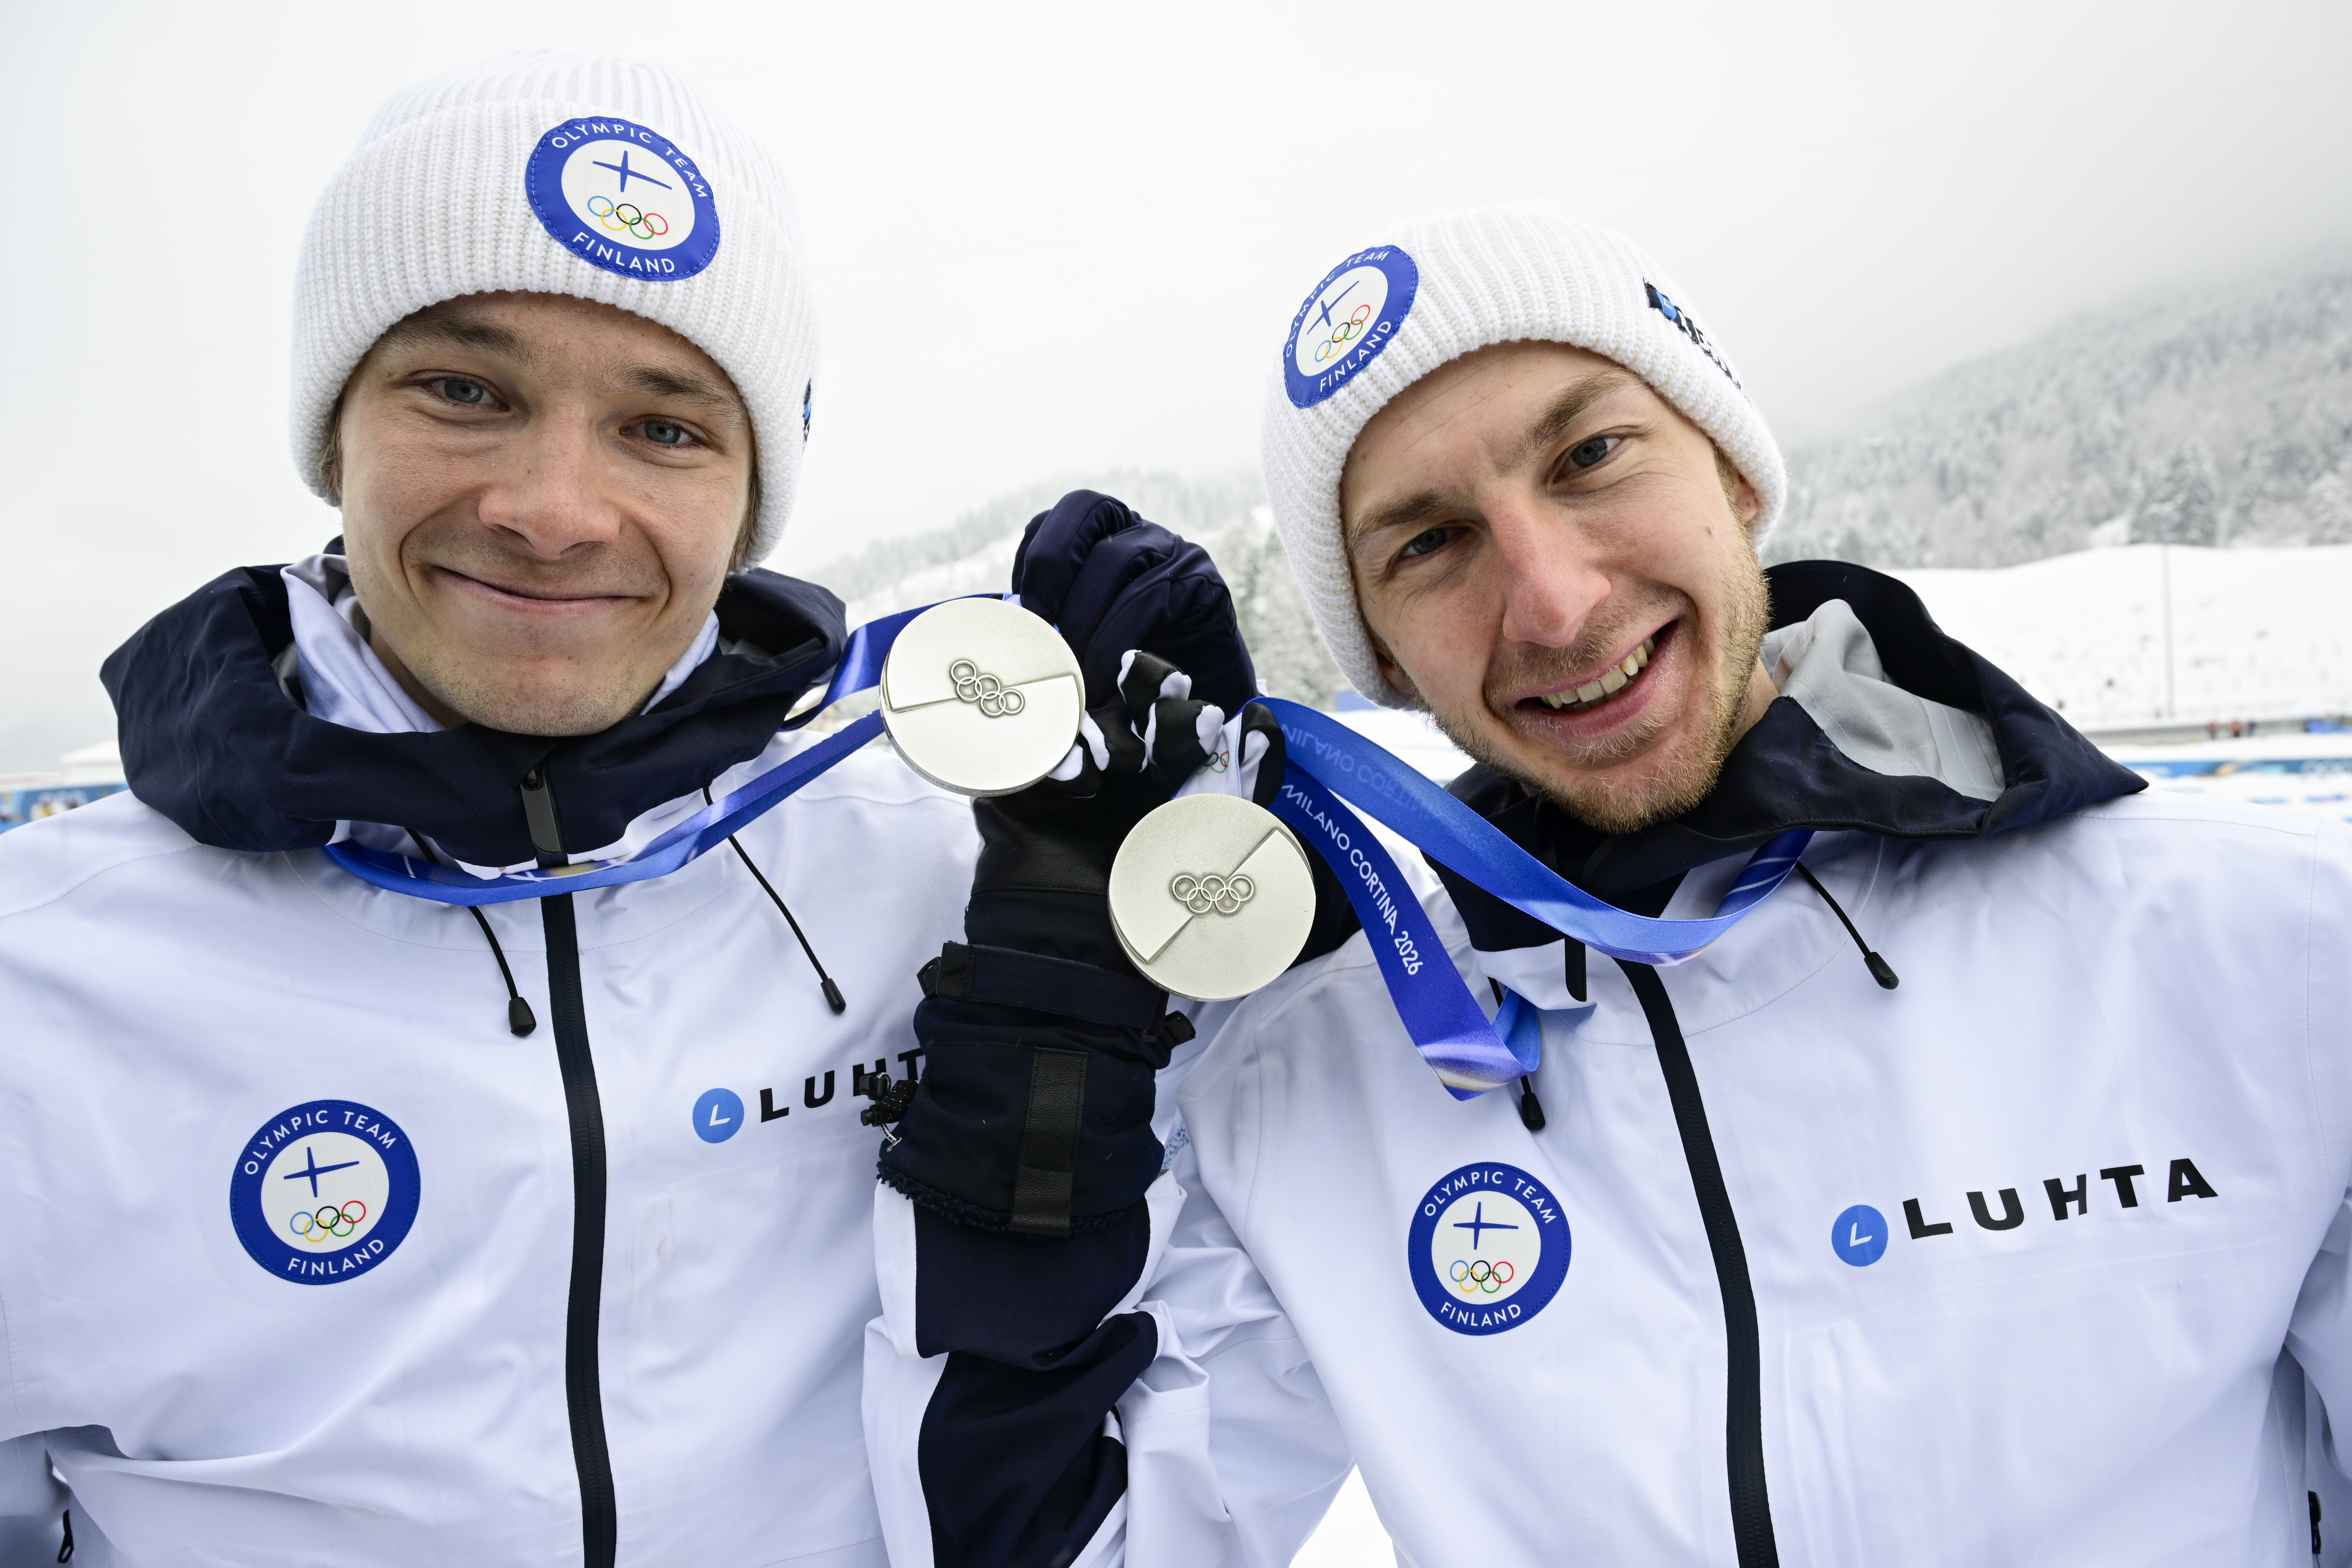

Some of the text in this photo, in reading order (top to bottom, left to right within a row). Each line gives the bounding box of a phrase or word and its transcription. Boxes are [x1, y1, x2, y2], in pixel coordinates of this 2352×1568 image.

[552, 123, 708, 197] OLYMPIC TEAM
[572, 231, 675, 273] FINLAND
[1286, 251, 1390, 357] OLYMPIC TEAM
[1320, 321, 1391, 392] FINLAND
[890, 737, 915, 768] YMPIC
[917, 767, 946, 786] WINTER
[1282, 785, 1423, 975] MILANO CORTINA 2026
[760, 1048, 926, 1123] LUHT
[244, 1110, 397, 1175] OLYMPIC TEAM
[1424, 1171, 1557, 1224] OLYMPIC TEAM
[1903, 1158, 2219, 1239] LUHTA
[287, 1239, 384, 1275] FINLAND
[1441, 1301, 1521, 1327] FINLAND
